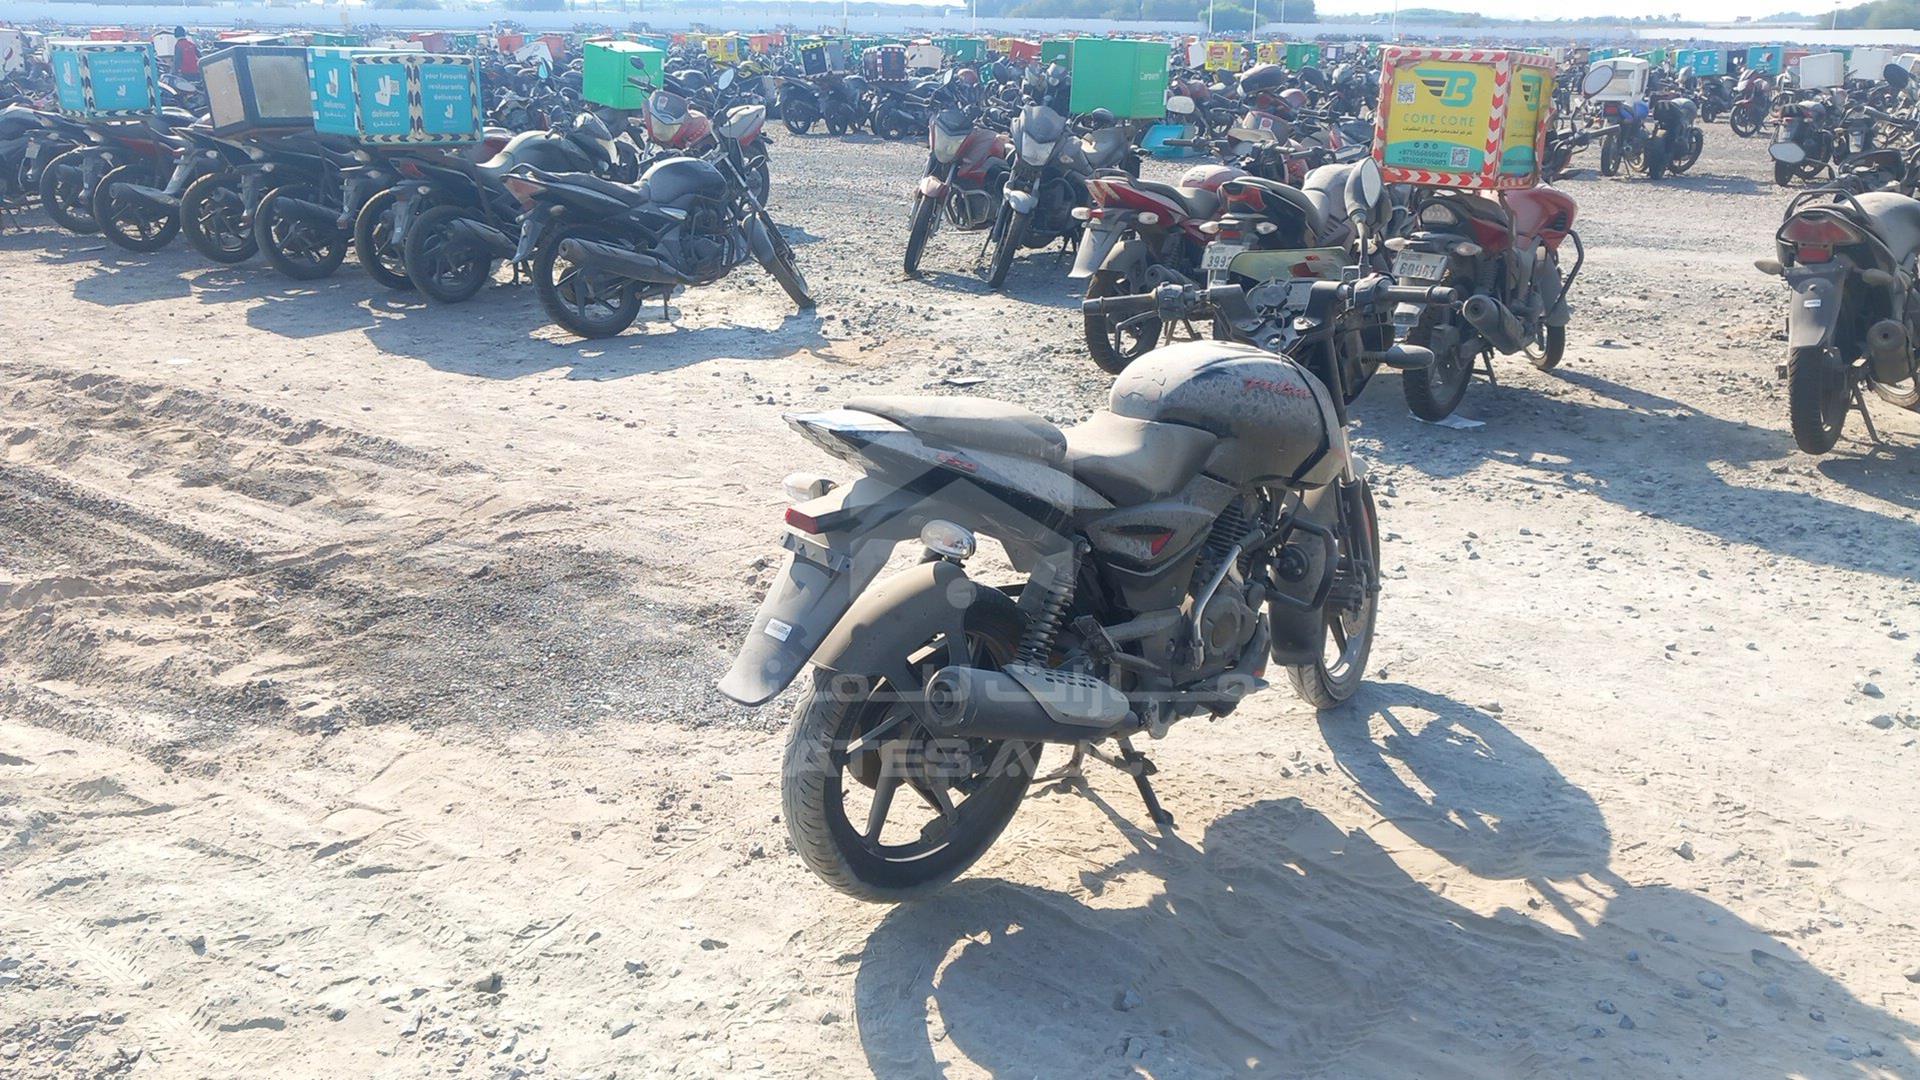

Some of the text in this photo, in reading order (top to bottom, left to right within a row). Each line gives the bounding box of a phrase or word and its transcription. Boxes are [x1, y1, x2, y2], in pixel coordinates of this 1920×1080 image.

[439, 72, 467, 80] favourite
[371, 110, 400, 119] deliveroo
[1403, 113, 1476, 127] COME COME
